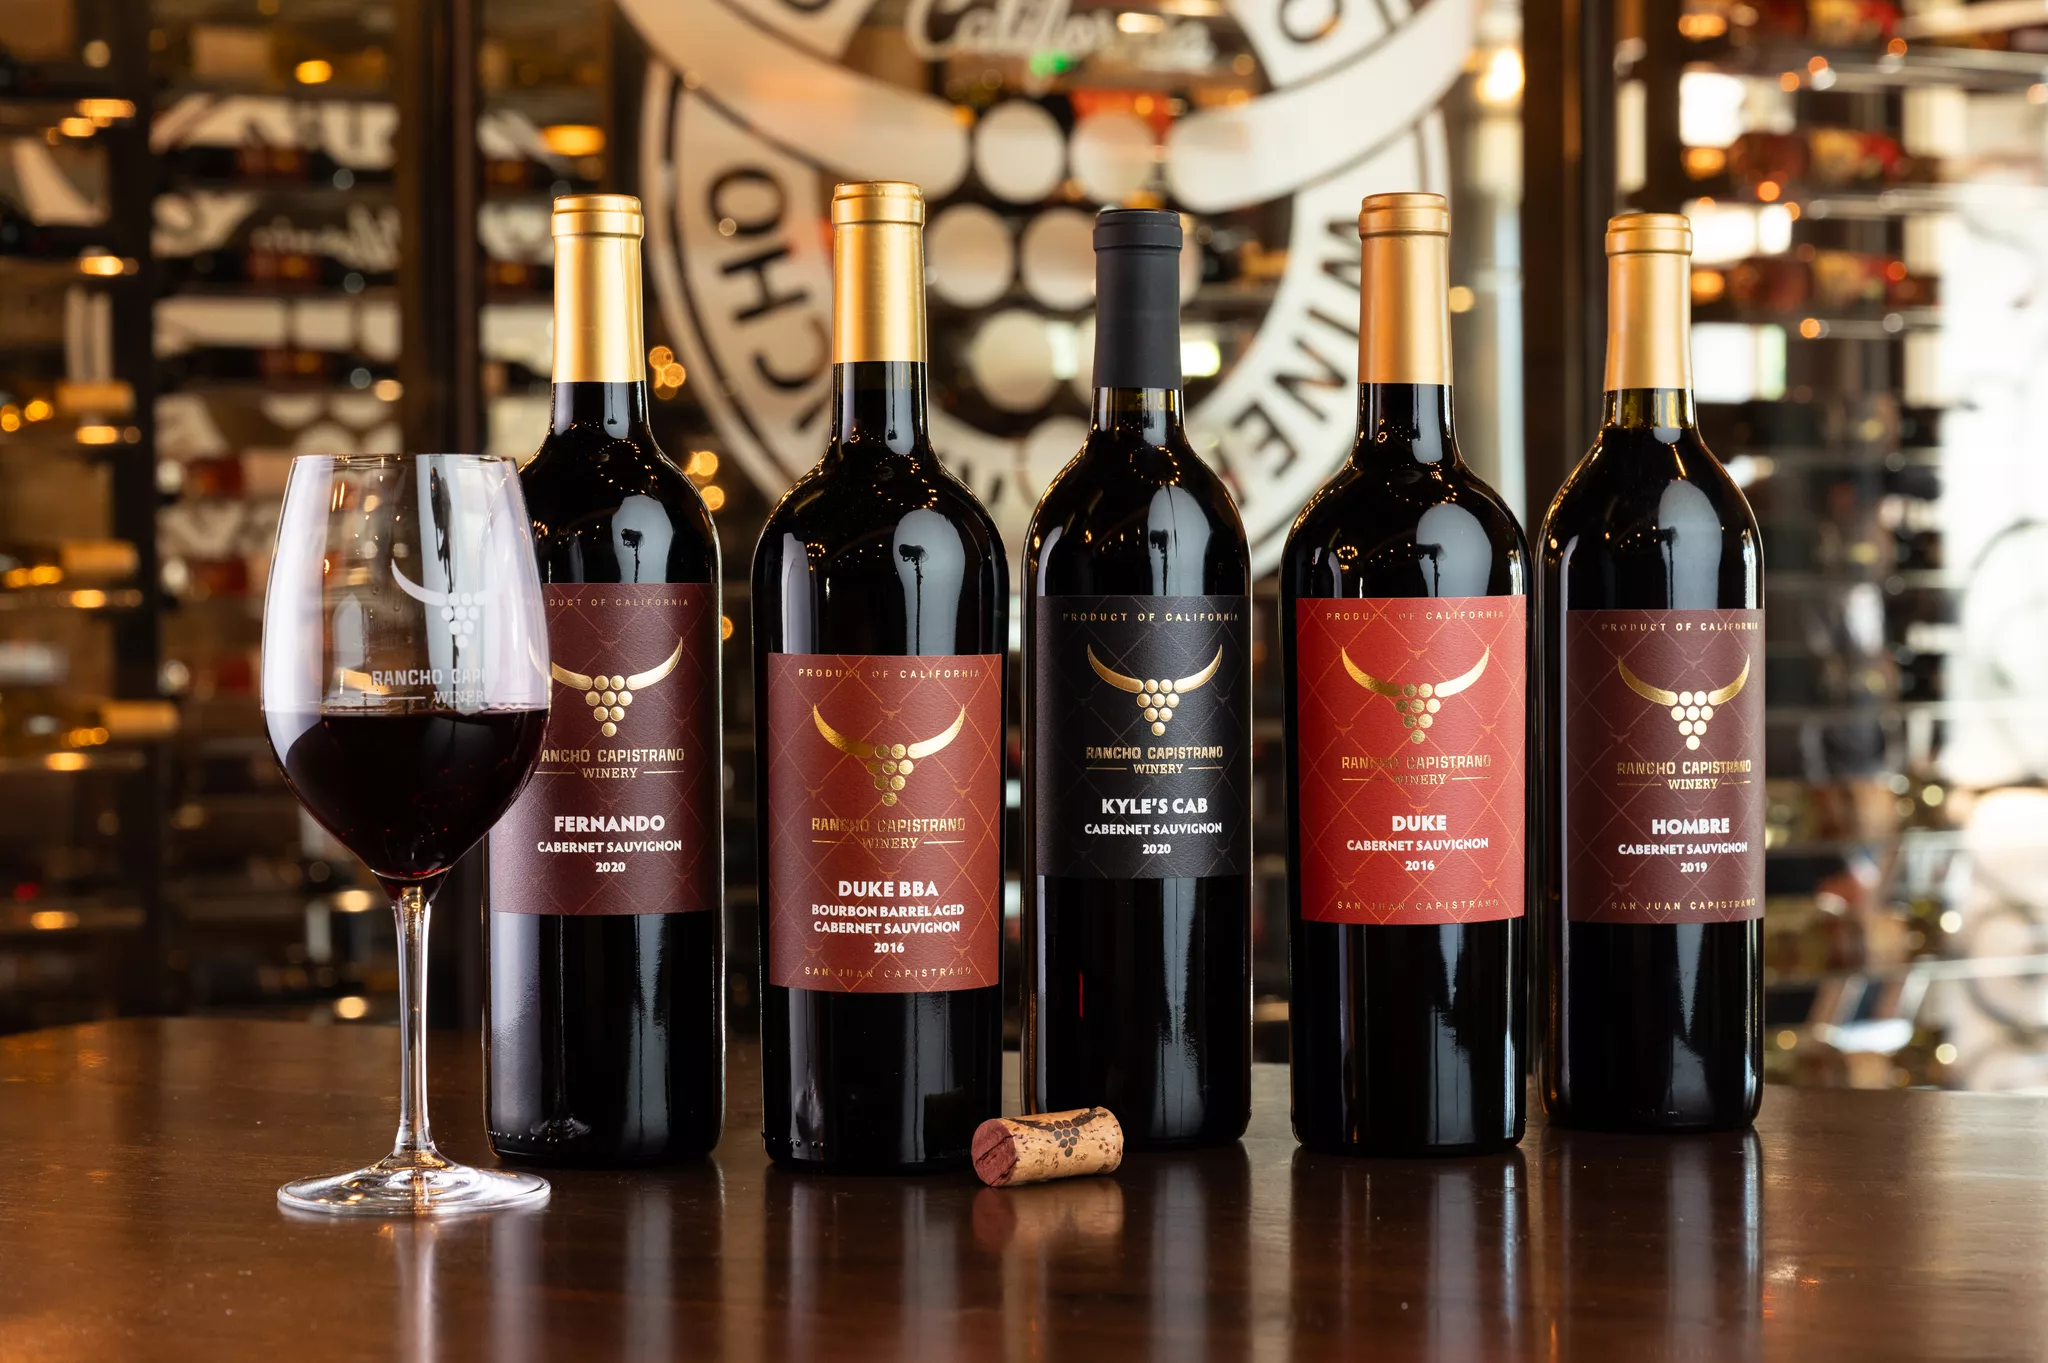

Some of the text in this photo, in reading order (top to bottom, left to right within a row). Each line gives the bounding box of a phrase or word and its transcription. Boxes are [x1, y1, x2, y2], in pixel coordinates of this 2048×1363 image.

[549, 598, 689, 607] DUCT OF CALIFORNIA
[1062, 612, 1239, 622] PRODUCT OF CALIFORNIA
[1326, 610, 1504, 621] PRODUCT OF CALIFORNIA
[1601, 623, 1666, 632] PRODUCT
[1675, 622, 1693, 632] OF
[371, 669, 443, 686] RANCHO
[798, 668, 981, 679] PRODUCT OF CALIFORNIA
[541, 748, 685, 763] ANCHO CAPISTRANO
[1086, 745, 1224, 760] RANCHO CAPISTRANO
[1341, 754, 1492, 769] RANCHO CAPISTRANO
[1617, 760, 1752, 775] RANCHO CAPISTRANO
[582, 767, 638, 779] WINERY
[1132, 763, 1184, 774] WINERY
[1391, 773, 1447, 785] WINERY
[1667, 778, 1719, 790] WINERY
[1101, 797, 1208, 814] KYLE'S CAB
[554, 815, 666, 833] FERNANDO
[811, 817, 966, 833] RANCHO CAPISTRANO
[1084, 822, 1223, 835] CABERNET SAUVIGNON
[1391, 814, 1447, 832] DUKE
[1651, 818, 1730, 835] HOMBRE
[537, 840, 682, 853] CABERNET SAUVIGNON
[861, 837, 919, 849] WINERY
[1142, 843, 1172, 855] 2020
[1346, 837, 1489, 852] CABERNET SAUVIGNON
[1617, 842, 1748, 855] CABERNET SAUVIGNON
[595, 862, 626, 873] 2020
[1404, 860, 1435, 871] 2016
[1680, 862, 1708, 873] 2019
[838, 880, 940, 897] DUKE BBA
[811, 903, 965, 918] BOURBON BARREL AGED
[1337, 899, 1499, 911] SAN JUAN CAPISTRANO
[1611, 898, 1757, 911] SAN JUAN CAPISTRANO
[813, 920, 961, 935] CABERNET SAUVIGNON
[873, 942, 905, 954] 2016
[804, 966, 971, 978] SAN JUAN CAPISTRANO
